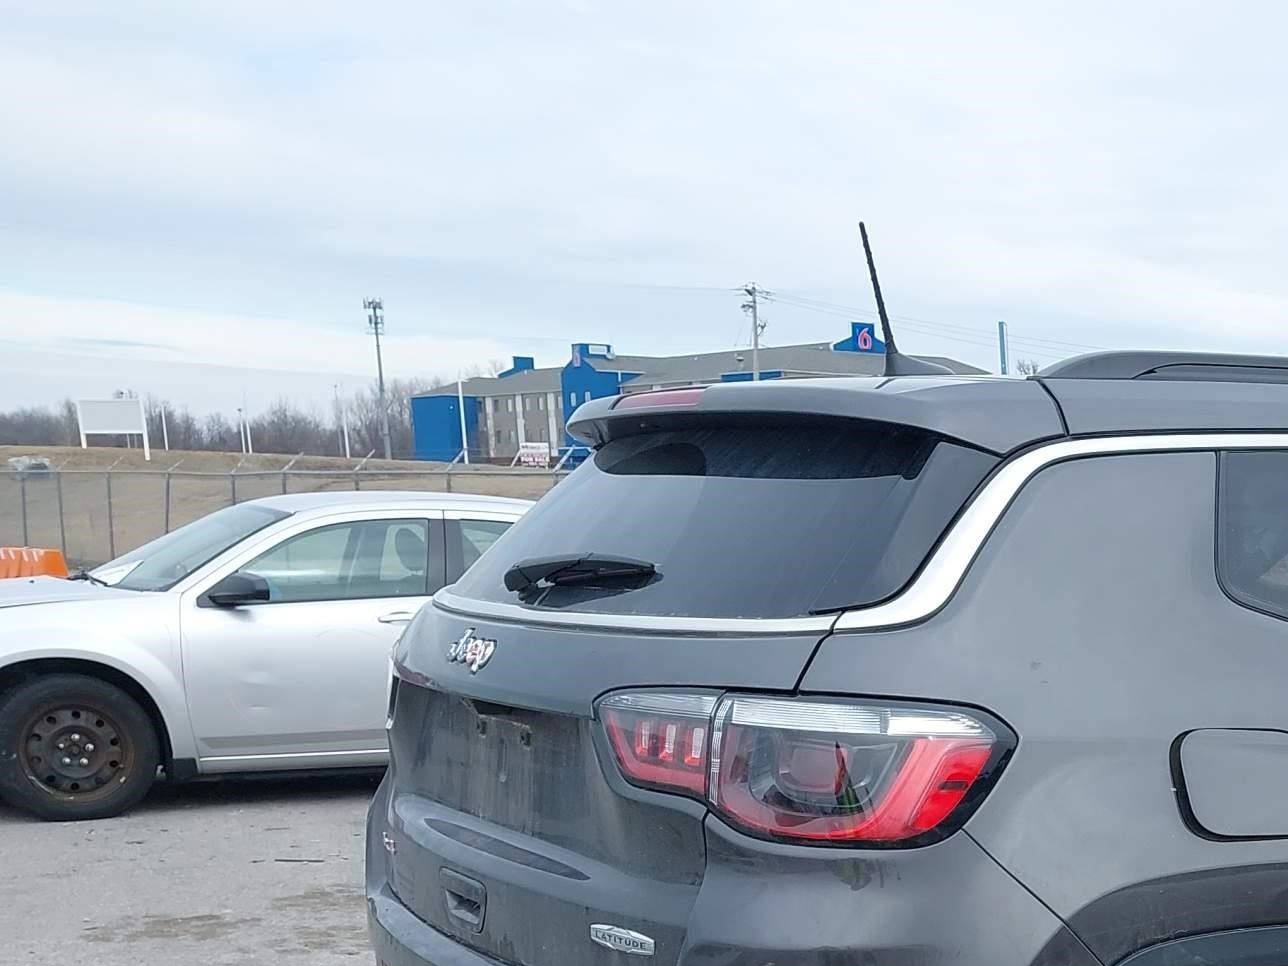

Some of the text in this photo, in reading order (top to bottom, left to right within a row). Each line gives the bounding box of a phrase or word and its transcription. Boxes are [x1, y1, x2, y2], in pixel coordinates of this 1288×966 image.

[857, 327, 873, 351] 6
[446, 627, 497, 675] Jeep
[595, 929, 648, 950] LATITUDE
